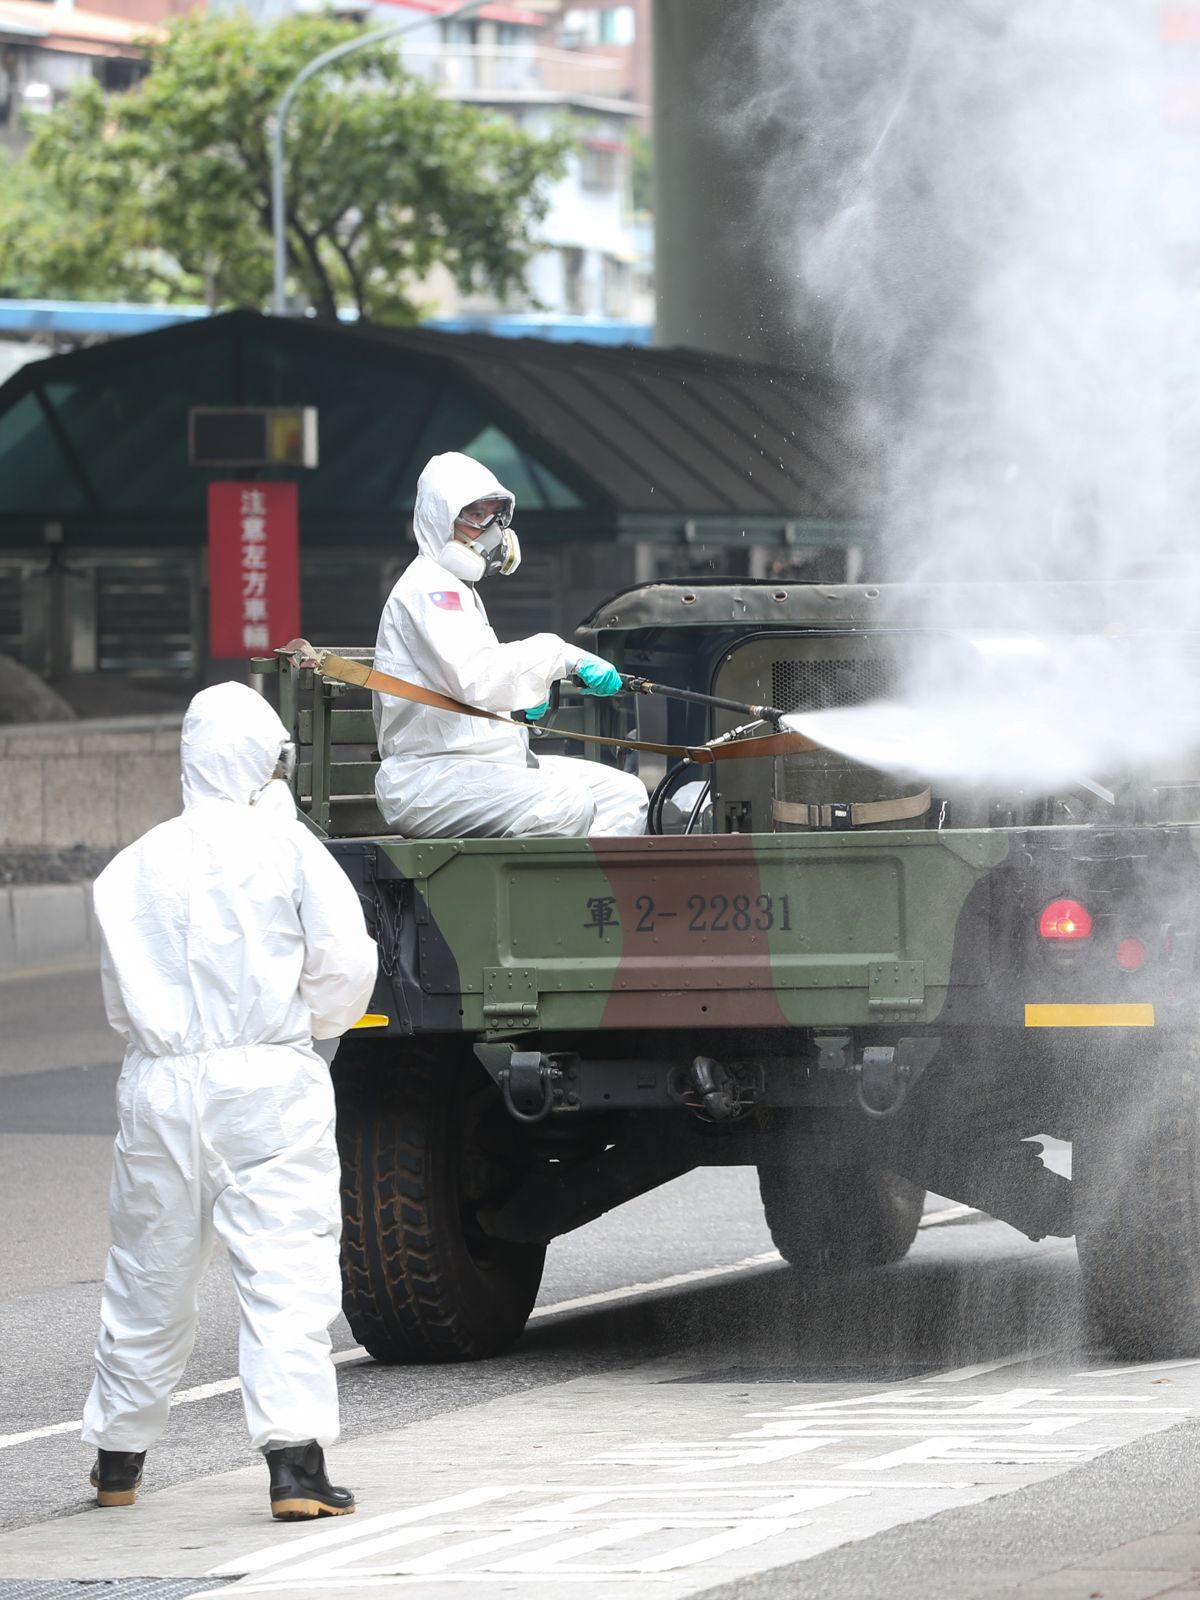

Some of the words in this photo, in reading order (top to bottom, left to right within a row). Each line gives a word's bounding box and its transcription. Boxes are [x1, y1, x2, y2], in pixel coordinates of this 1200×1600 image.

[240, 488, 269, 649] 注意左方車輛
[583, 896, 619, 938] 軍
[635, 894, 793, 932] 2-22831
